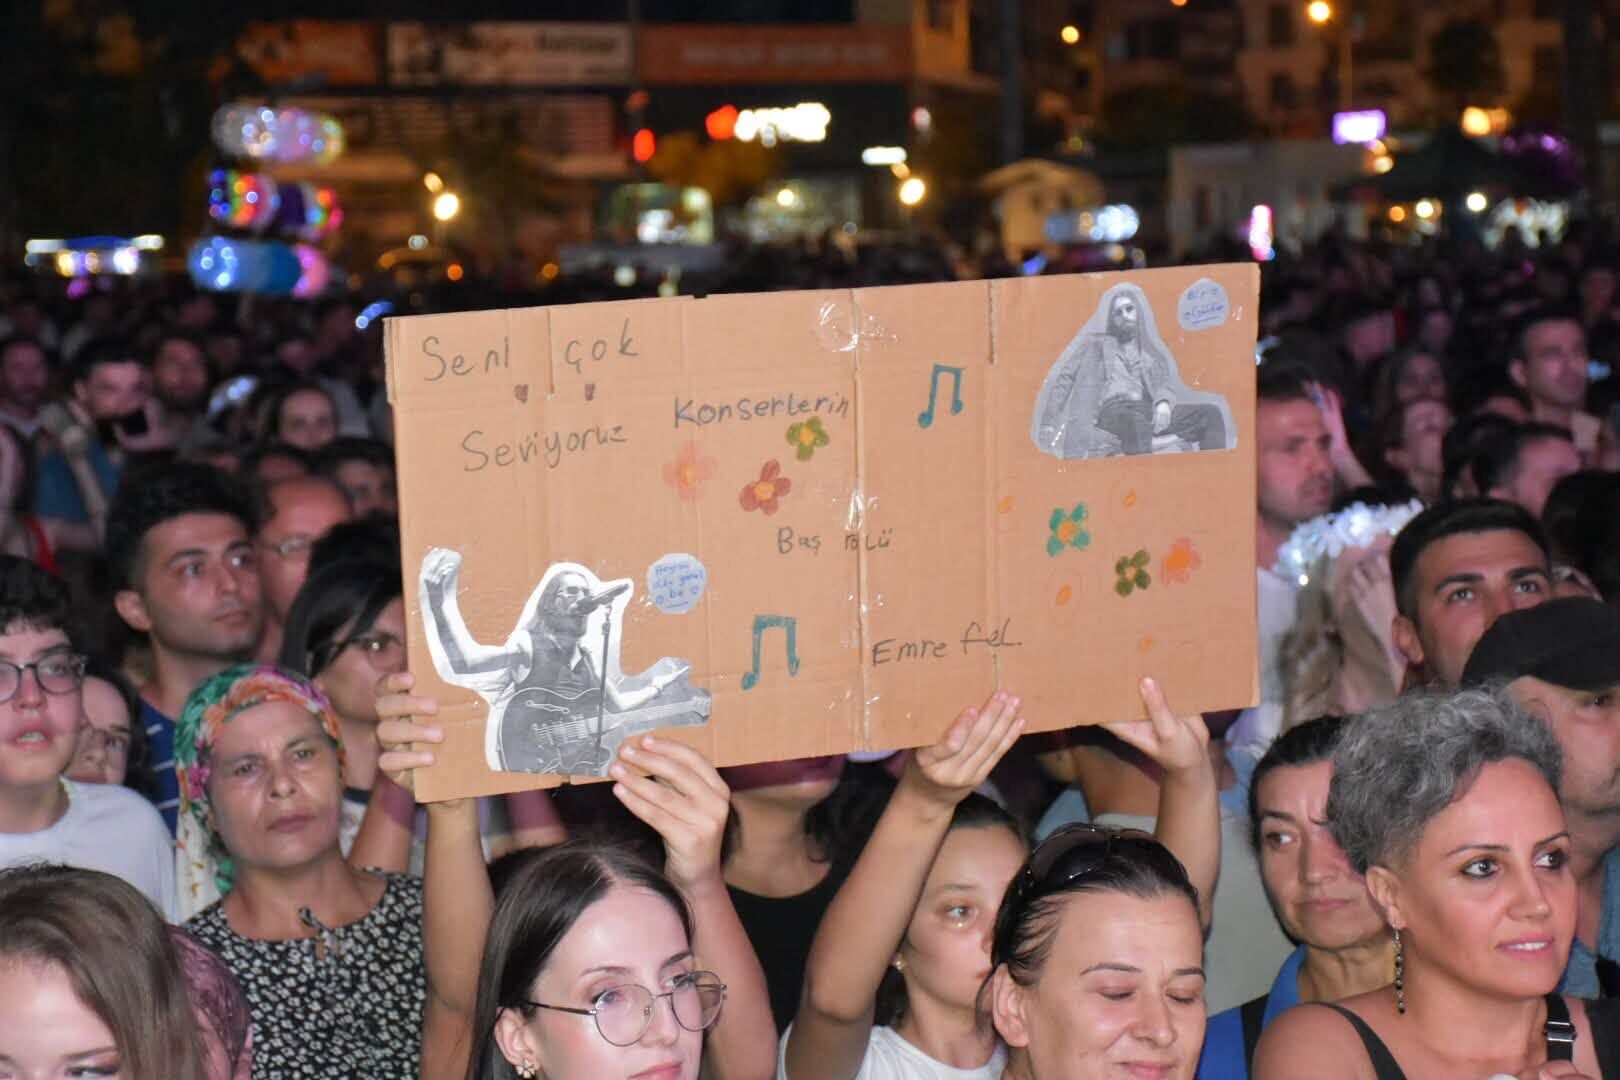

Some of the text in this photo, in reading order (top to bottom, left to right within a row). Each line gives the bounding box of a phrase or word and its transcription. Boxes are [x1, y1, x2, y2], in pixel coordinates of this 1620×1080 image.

[674, 391, 850, 429] Konserlerin
[461, 425, 628, 472] Seviyoruz
[871, 638, 947, 668] Emre
